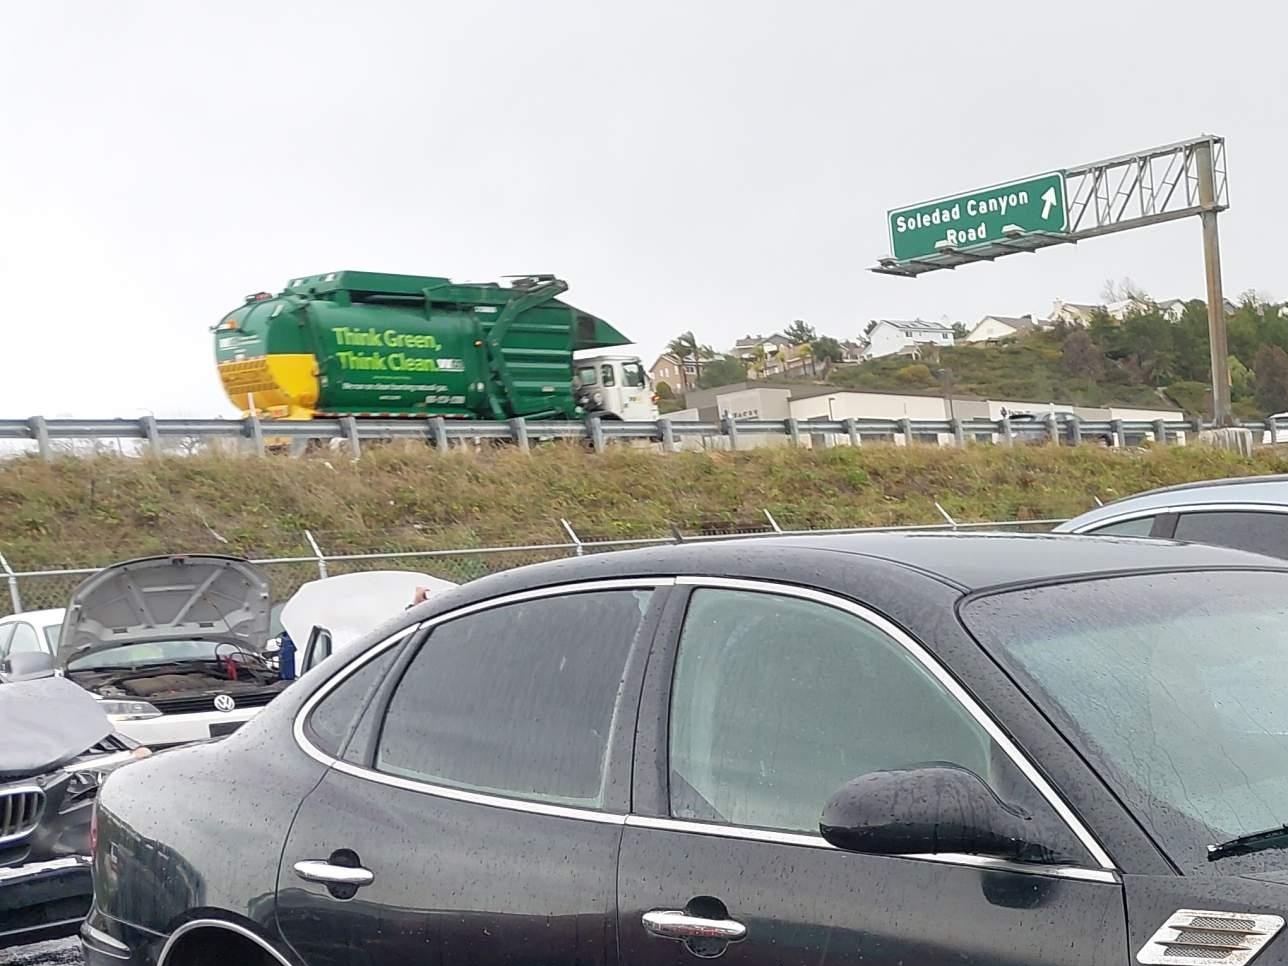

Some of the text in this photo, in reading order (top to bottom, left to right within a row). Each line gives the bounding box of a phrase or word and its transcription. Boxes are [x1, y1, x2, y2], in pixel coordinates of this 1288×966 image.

[897, 191, 1028, 232] Soledad Canyon
[946, 223, 987, 244] Road
[331, 327, 442, 351] Think Green,
[335, 351, 387, 370] Think
